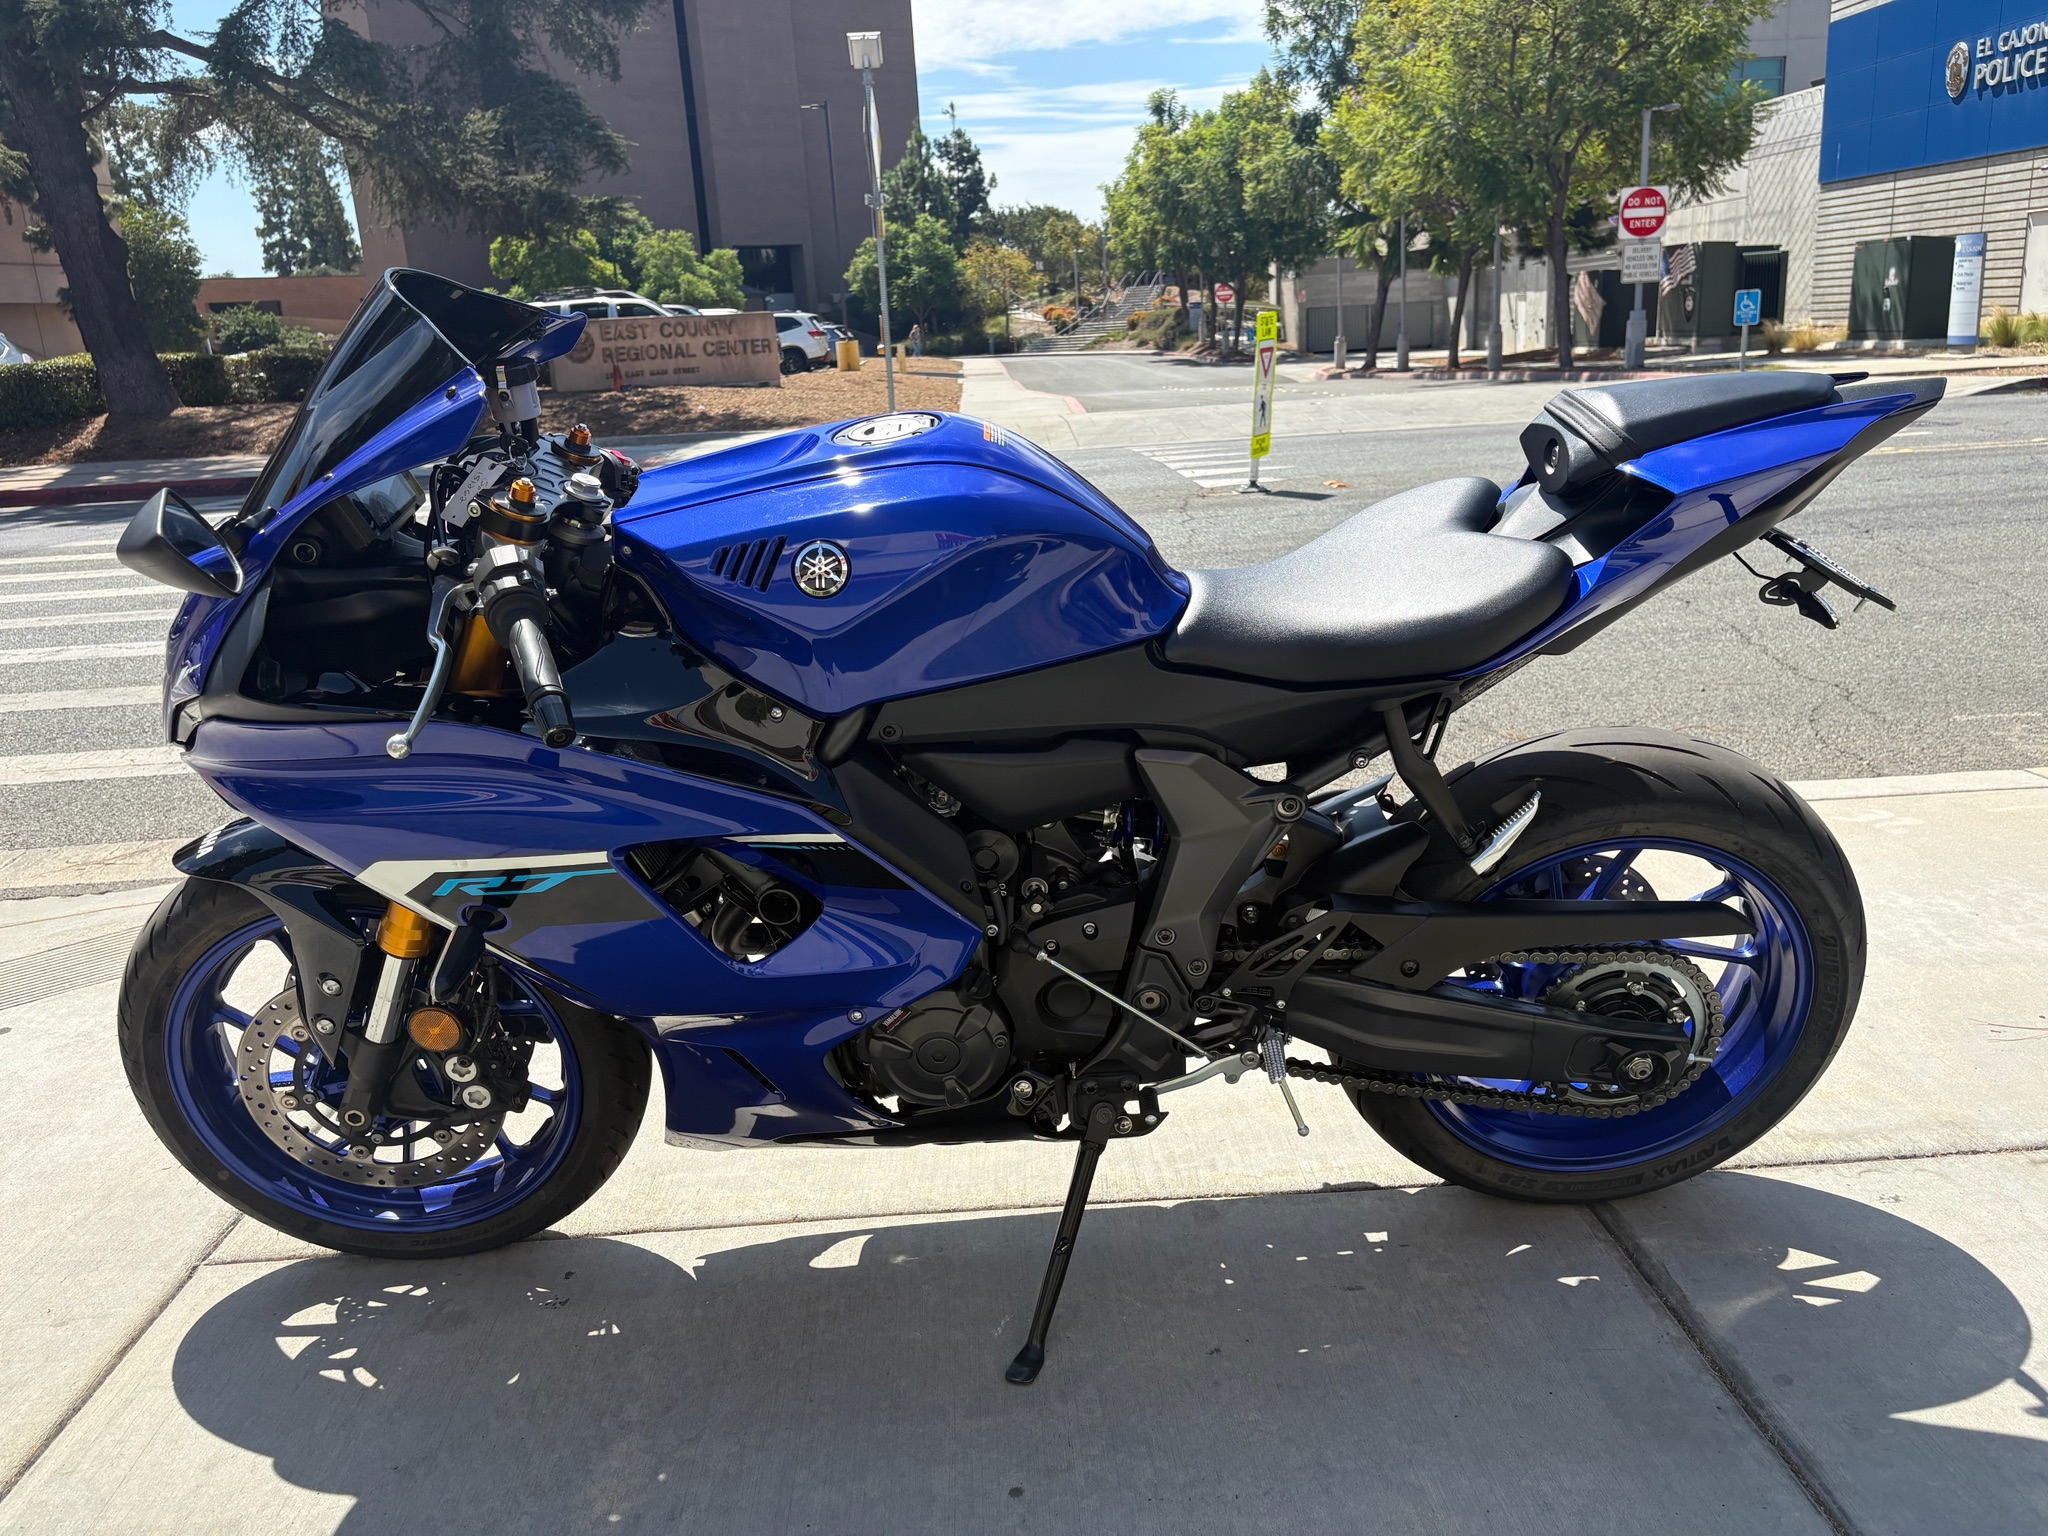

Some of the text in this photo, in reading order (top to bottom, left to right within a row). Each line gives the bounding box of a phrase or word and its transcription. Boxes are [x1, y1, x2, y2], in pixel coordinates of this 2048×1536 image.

[1976, 37, 1994, 58] EL
[1973, 46, 2048, 90] POLICE
[1627, 196, 1662, 207] DO NOT
[1629, 219, 1657, 229] ENTER
[600, 319, 736, 342] EAST COUNTY
[602, 338, 772, 363] REGIONAL CENTER
[625, 370, 644, 379] EAST
[673, 367, 700, 376] STREET
[431, 871, 578, 896] R7
[1652, 1135, 1733, 1181] BATTLAX
